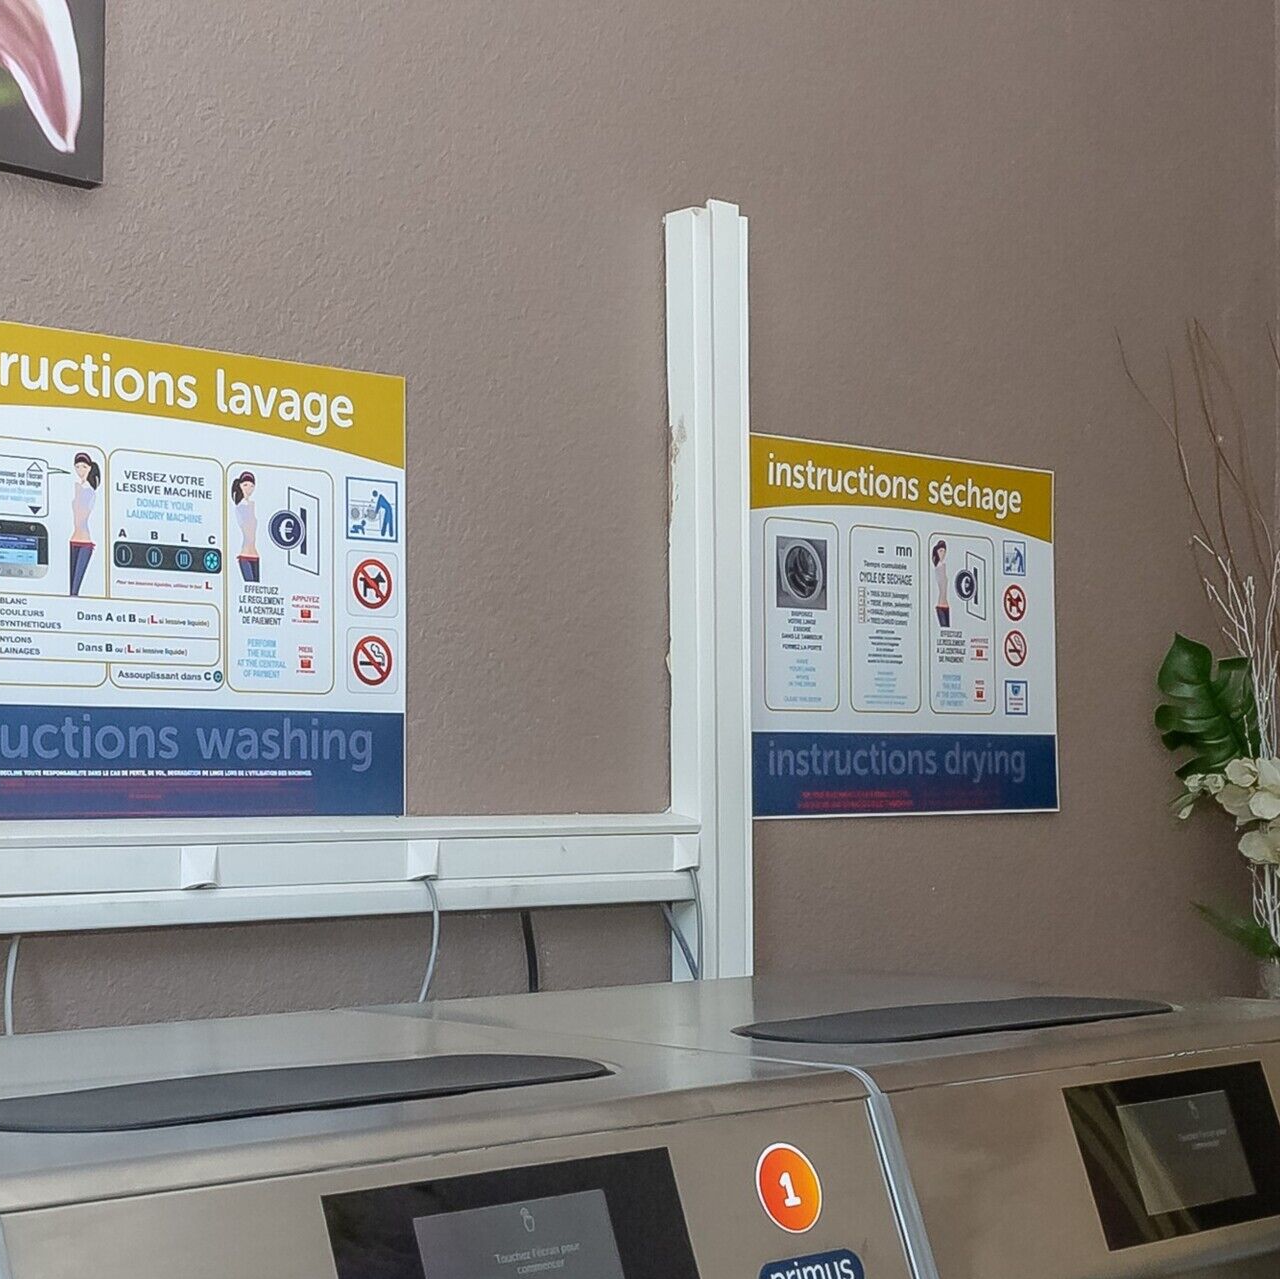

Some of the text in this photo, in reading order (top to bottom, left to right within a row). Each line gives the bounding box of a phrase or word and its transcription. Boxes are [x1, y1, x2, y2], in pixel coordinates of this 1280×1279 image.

[216, 368, 354, 436] lavage
[124, 471, 205, 487] VERSEZ VOTRE
[116, 483, 213, 500] LESSIVE MACHINE
[767, 453, 1022, 520] instructions séchage
[137, 498, 194, 511] DONATE YOUR
[127, 510, 203, 524] LAUNDRY MACHINE
[119, 529, 216, 545] A B L C
[896, 546, 913, 557] mn
[860, 571, 877, 584] CYCLE
[878, 573, 886, 584] DE
[205, 582, 213, 590] L
[245, 585, 279, 595] EFFECTUEZ
[248, 596, 285, 605] REGLEMENT
[292, 595, 320, 603] APPUYEZ
[0, 609, 45, 617] COULEURS
[77, 611, 103, 621] Dans
[105, 613, 114, 622] A
[129, 614, 136, 623] B
[244, 607, 253, 615] LA
[253, 606, 285, 616] CENTRALE
[0, 620, 62, 630] SYNTHETIQUES
[252, 618, 282, 626] PAIEMENT
[0, 636, 33, 644] NYLONS
[248, 639, 276, 648] PERFORM
[0, 647, 41, 656] LAINAGES
[77, 643, 103, 652] Dans
[105, 644, 113, 652] B
[118, 670, 211, 683] Assouplissant dans C
[253, 670, 280, 678] PAYMENT
[196, 718, 374, 772] washing
[768, 740, 1026, 783] instructions drying
[779, 1172, 802, 1207] 1
[561, 1243, 580, 1255] pour
[517, 1259, 565, 1274] commencer
